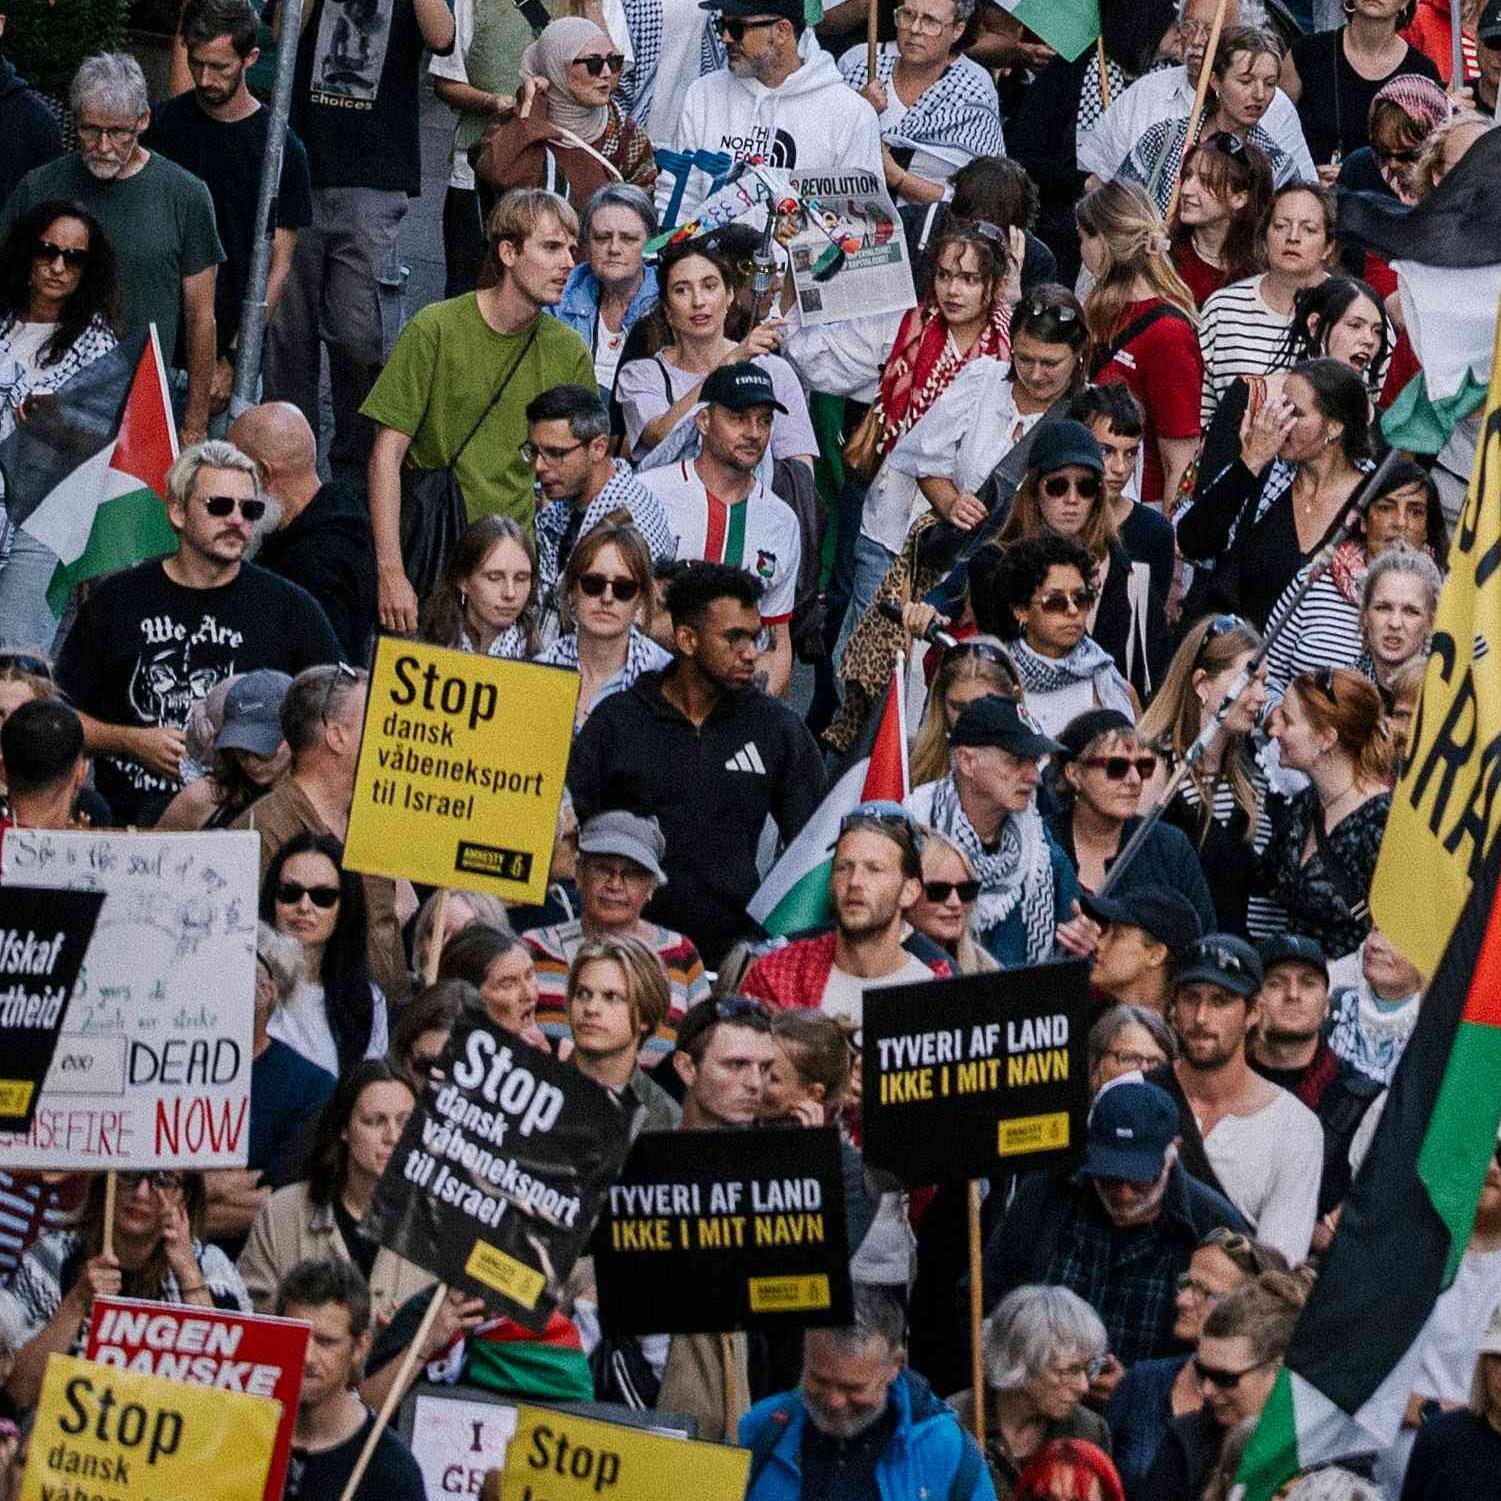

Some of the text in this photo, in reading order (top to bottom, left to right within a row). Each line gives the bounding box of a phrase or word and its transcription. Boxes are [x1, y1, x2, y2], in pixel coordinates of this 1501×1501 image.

[310, 93, 373, 111] choices
[800, 175, 880, 198] REVOLUTION
[140, 613, 244, 648] We Are
[389, 655, 499, 730] Stop
[382, 711, 456, 748] dansk
[378, 743, 545, 798] våbeneksport
[371, 778, 475, 821] til Israel
[128, 1037, 241, 1087] DEAD
[877, 1013, 1070, 1072] TYVERI AF LAND
[453, 1028, 566, 1138] Stop
[879, 1047, 1070, 1106] IKKE I MIT NAVN
[154, 1095, 249, 1157] NOW
[435, 1083, 510, 1148] dansk
[403, 1150, 509, 1229] til Israel
[421, 1116, 581, 1229] våbeneksport
[608, 1177, 823, 1218] TYVERI AF LAND
[610, 1213, 825, 1253] IKKE I MIT NAVN
[97, 1308, 244, 1357] INGEN
[59, 1376, 186, 1464] Stop
[470, 1421, 484, 1452] I
[47, 1442, 132, 1486] dansk
[527, 1426, 620, 1493] Stop
